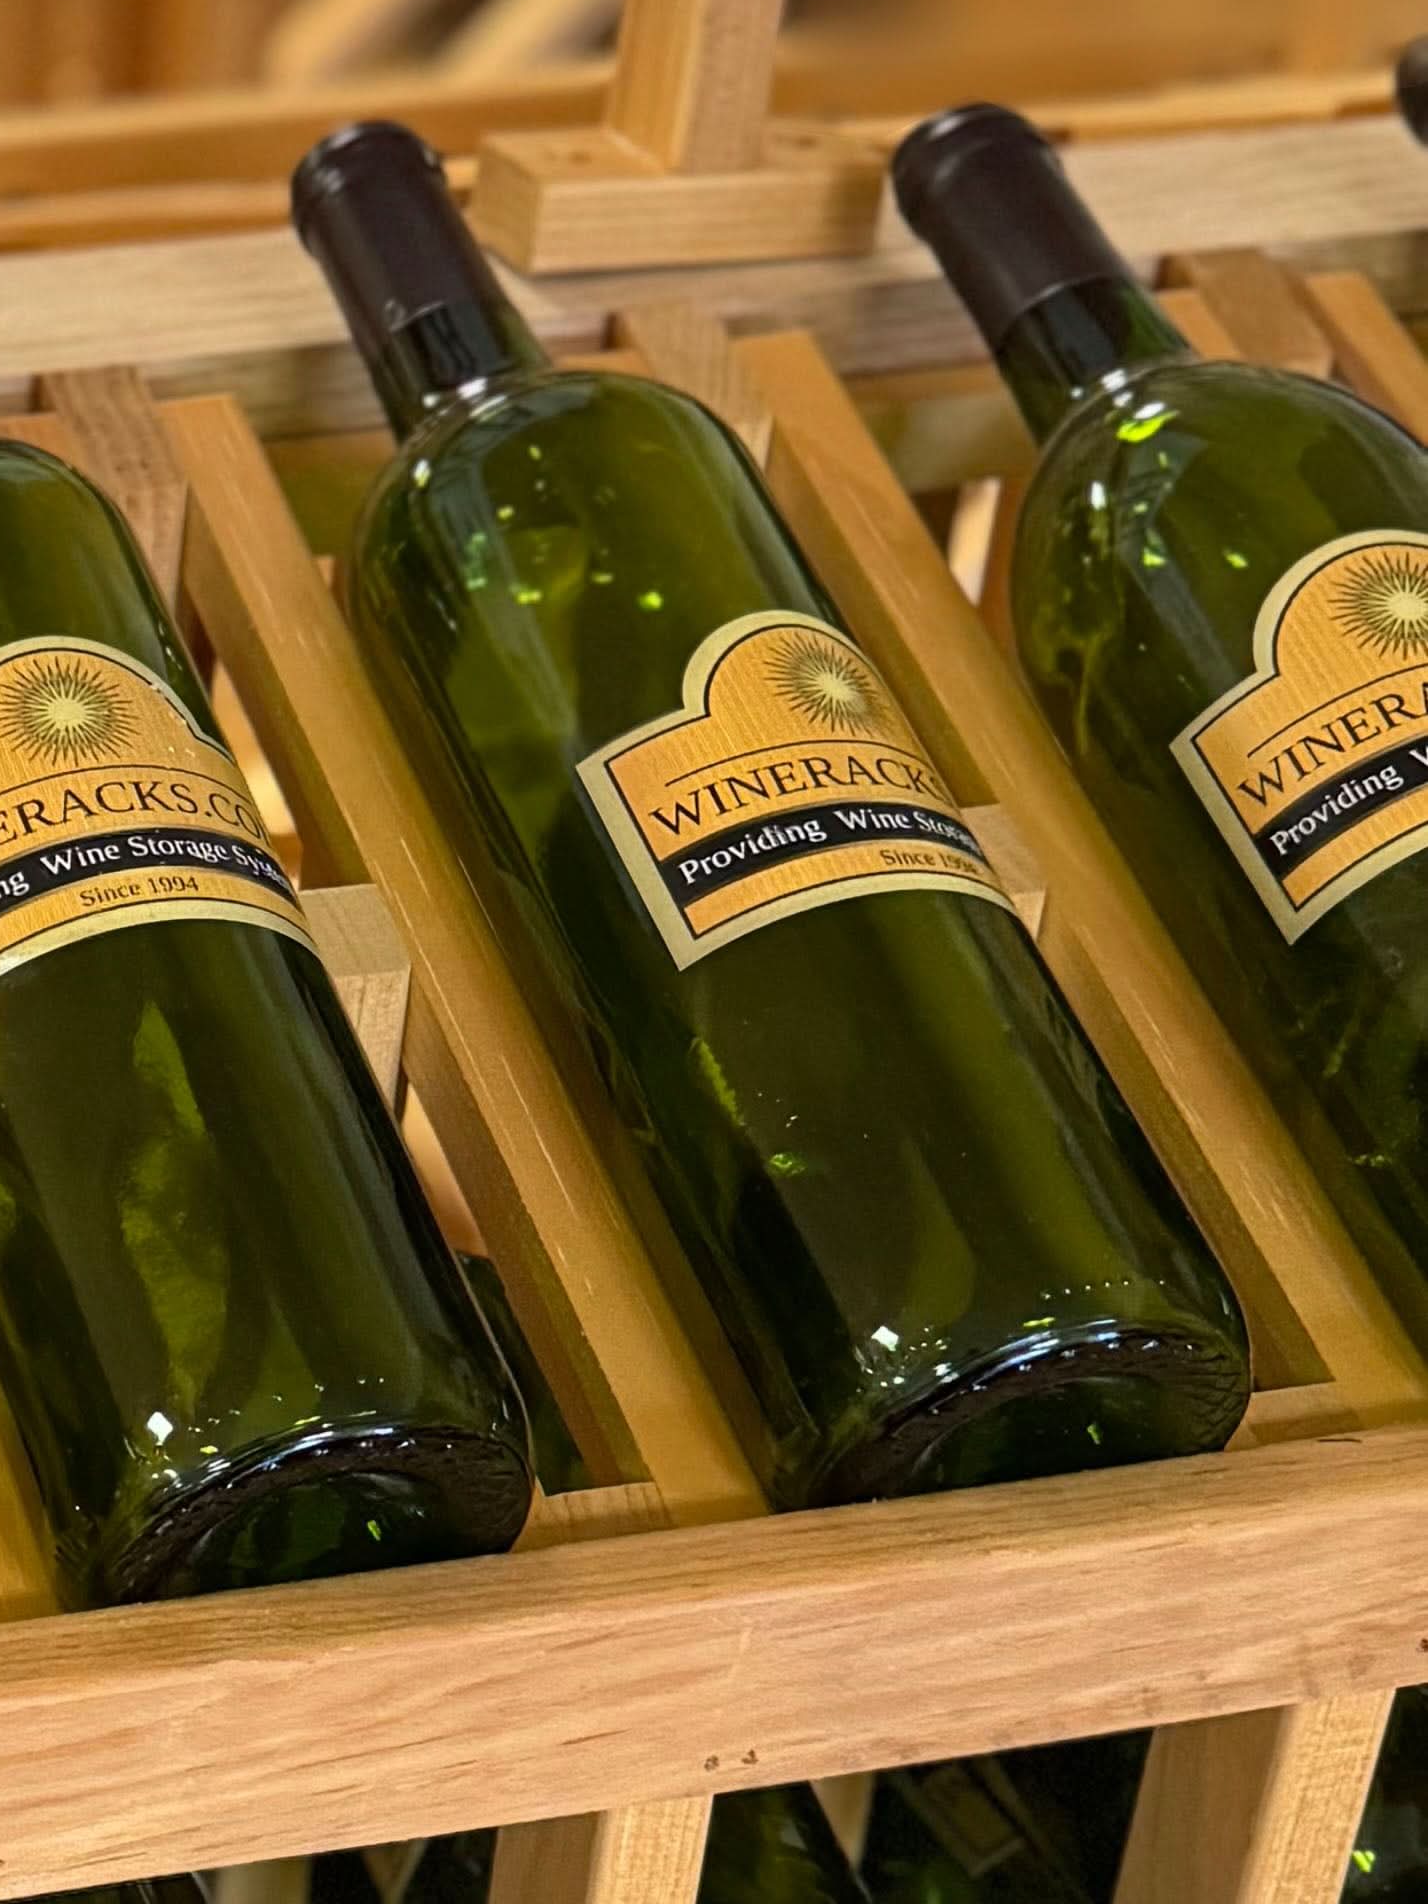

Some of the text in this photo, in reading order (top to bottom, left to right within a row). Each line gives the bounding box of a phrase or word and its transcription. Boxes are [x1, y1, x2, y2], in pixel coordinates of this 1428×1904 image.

[650, 756, 949, 837] WINERACK
[1270, 764, 1404, 856] Providing
[39, 845, 121, 877] Wine
[127, 835, 231, 864] Storage
[678, 815, 827, 885] Providing
[834, 809, 913, 830] Wine
[880, 849, 936, 867] Since
[79, 876, 200, 907] Since 1994
